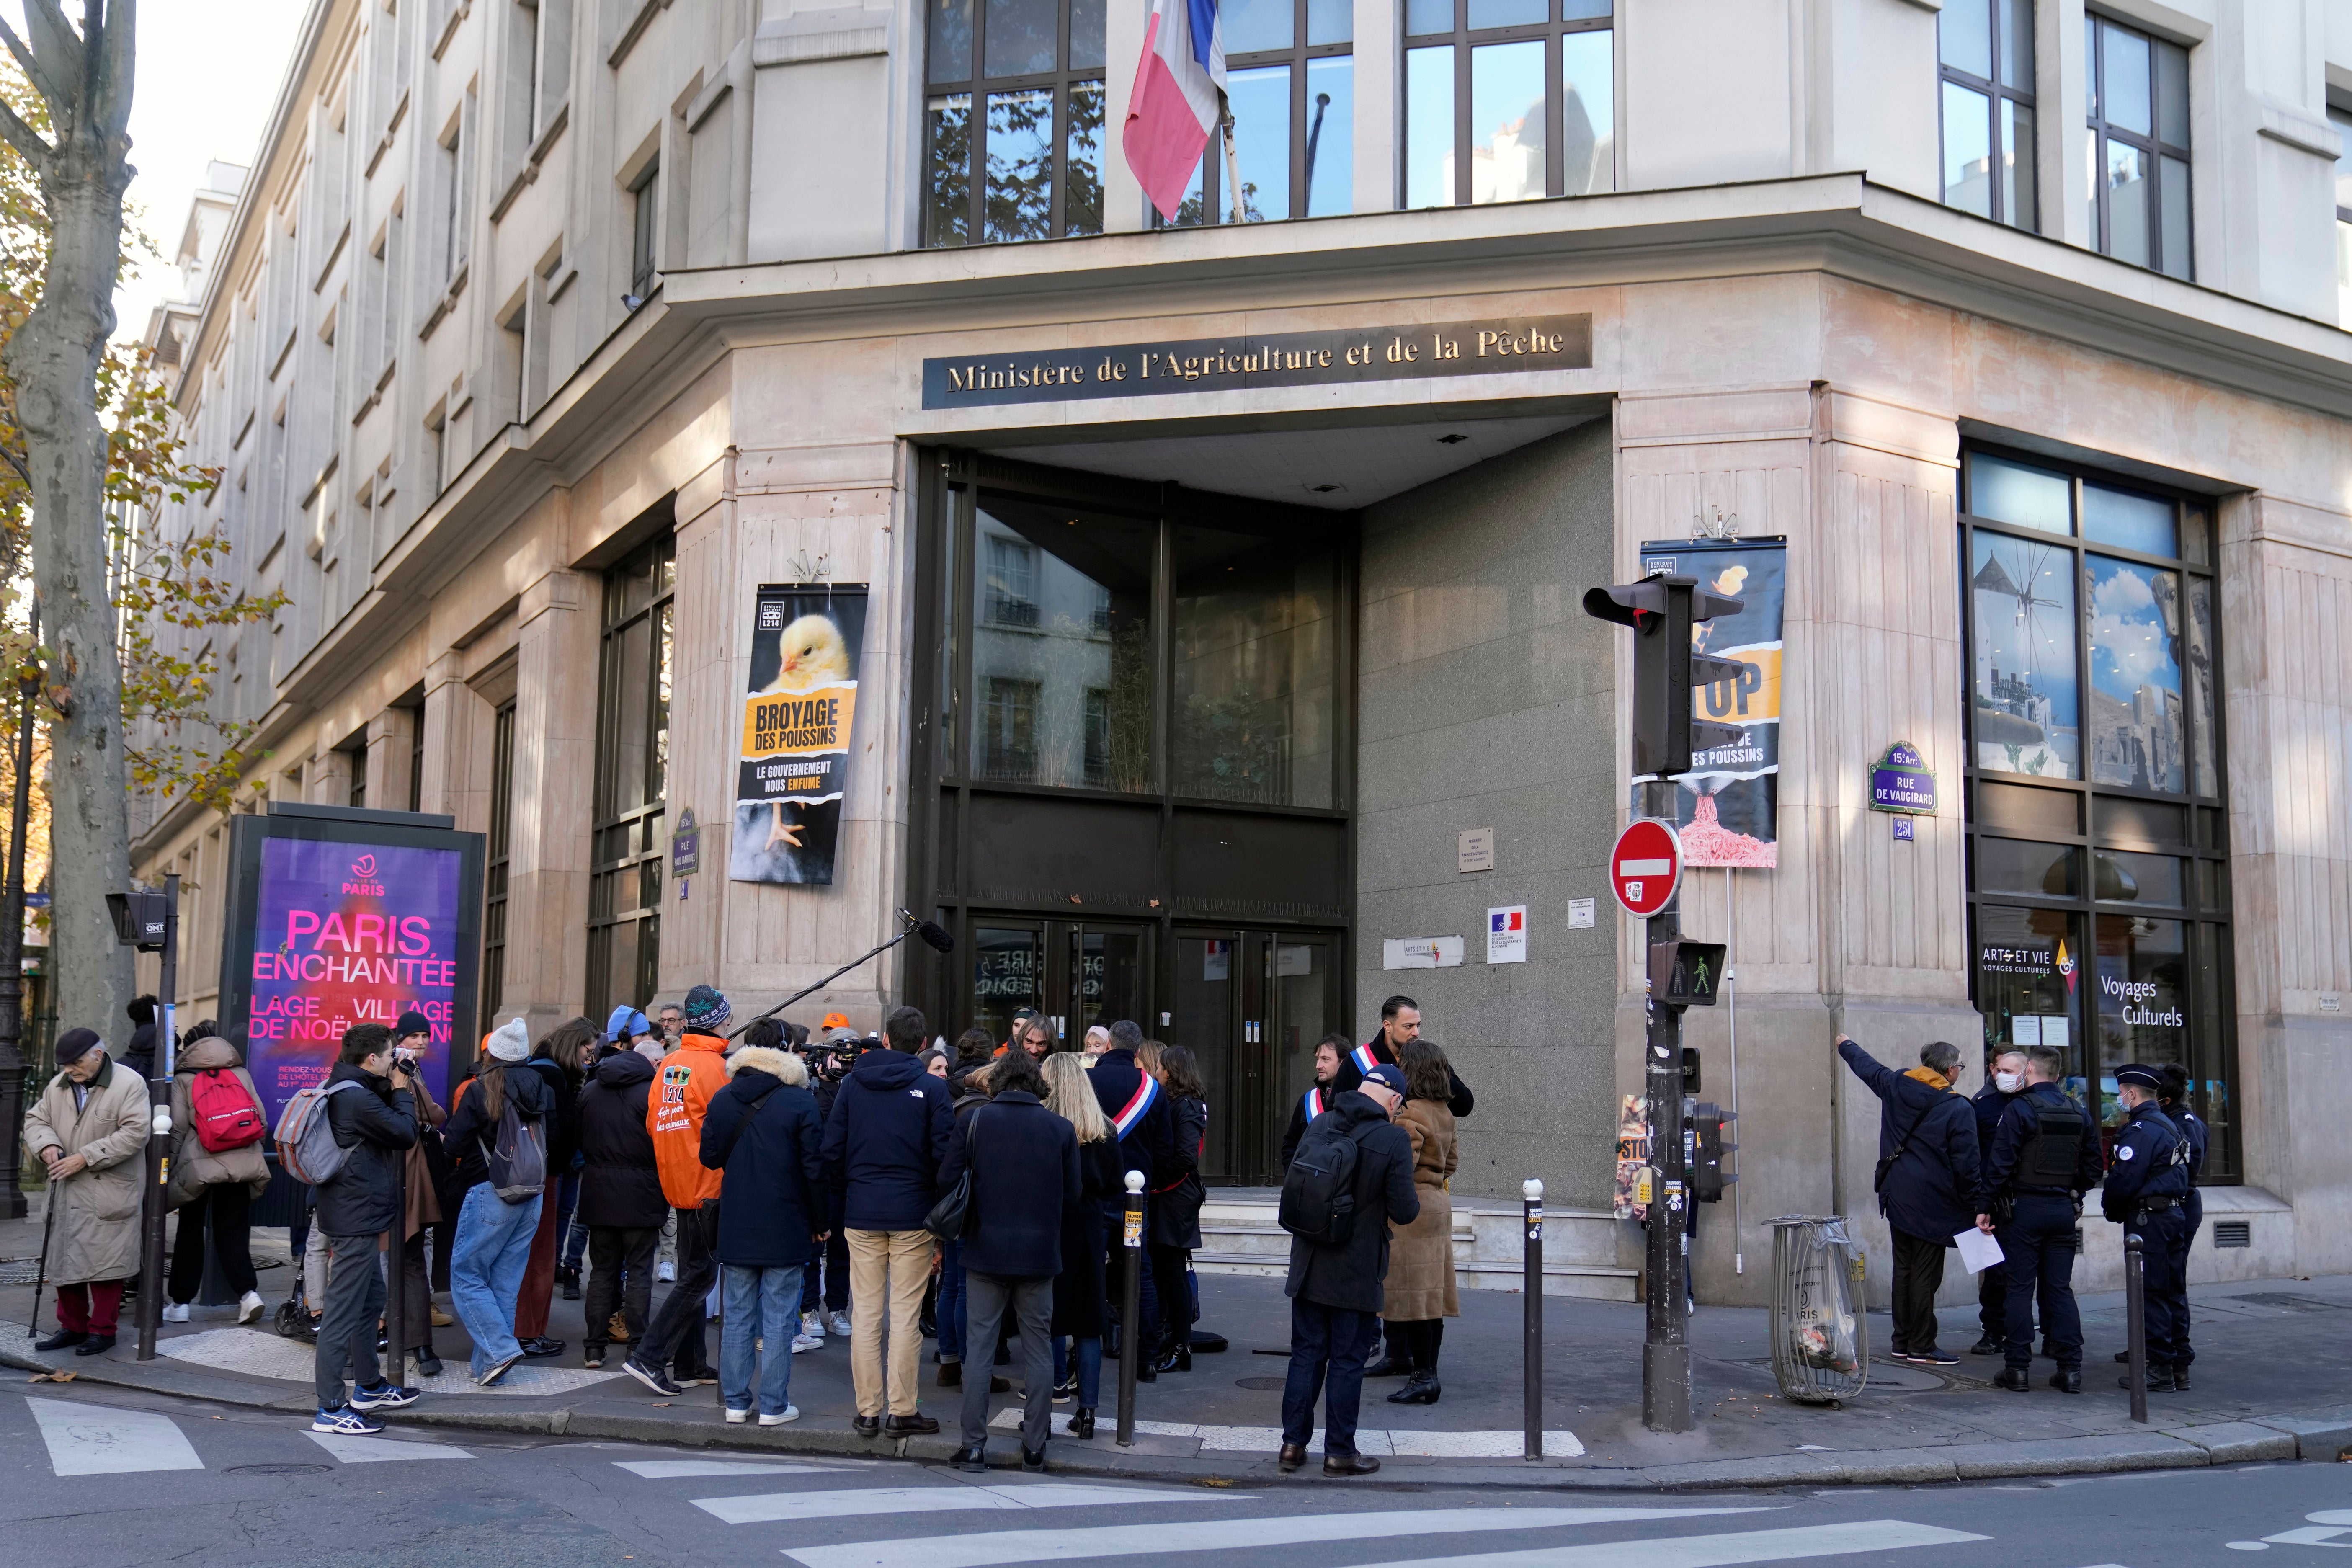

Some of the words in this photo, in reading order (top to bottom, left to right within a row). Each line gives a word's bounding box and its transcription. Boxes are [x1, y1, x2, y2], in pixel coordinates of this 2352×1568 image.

[946, 360, 1085, 392] Ministère
[1097, 356, 1127, 382] de
[1140, 346, 1333, 381] l'Agriculture
[1346, 341, 1374, 365] et
[1387, 337, 1419, 363] de
[1433, 334, 1461, 361] la
[1475, 328, 1565, 358] Pêche
[756, 698, 838, 733] BROYAGE
[755, 732, 775, 751] DES
[779, 727, 837, 748] POUSSINS
[1691, 752, 1706, 766] ES
[1709, 748, 1764, 765] POUSSINS
[756, 766, 766, 779] LE
[767, 761, 832, 778] GOUVERNEMENT
[765, 779, 786, 792] NOUS
[788, 776, 820, 790] ENFUME
[1897, 777, 1914, 789] RUE
[1876, 788, 1888, 799] DE
[1890, 790, 1933, 805] VAUGIRARD
[1897, 820, 1911, 837] 251
[682, 853, 696, 865] BARRUEL
[342, 882, 385, 897] PARIS
[681, 882, 685, 896] 2
[287, 910, 431, 956] PARIS
[1983, 947, 2011, 962] ARTS
[2016, 950, 2028, 963] ET
[2032, 951, 2050, 964] VIE
[253, 952, 456, 987] ENCHANTÉE
[1983, 964, 2012, 972] VOYAGES
[2014, 966, 2050, 975] CULTURELS
[2101, 975, 2156, 1002] Voyages
[251, 995, 320, 1018] LAGE
[2122, 1004, 2182, 1027] Culturels
[248, 1018, 284, 1039] DE
[290, 1072, 320, 1081] L'HÔTEL
[663, 1086, 684, 1104] L214
[657, 1120, 665, 1132] les
[665, 1119, 690, 1130] animaux
[1622, 1139, 1647, 1159] STO
